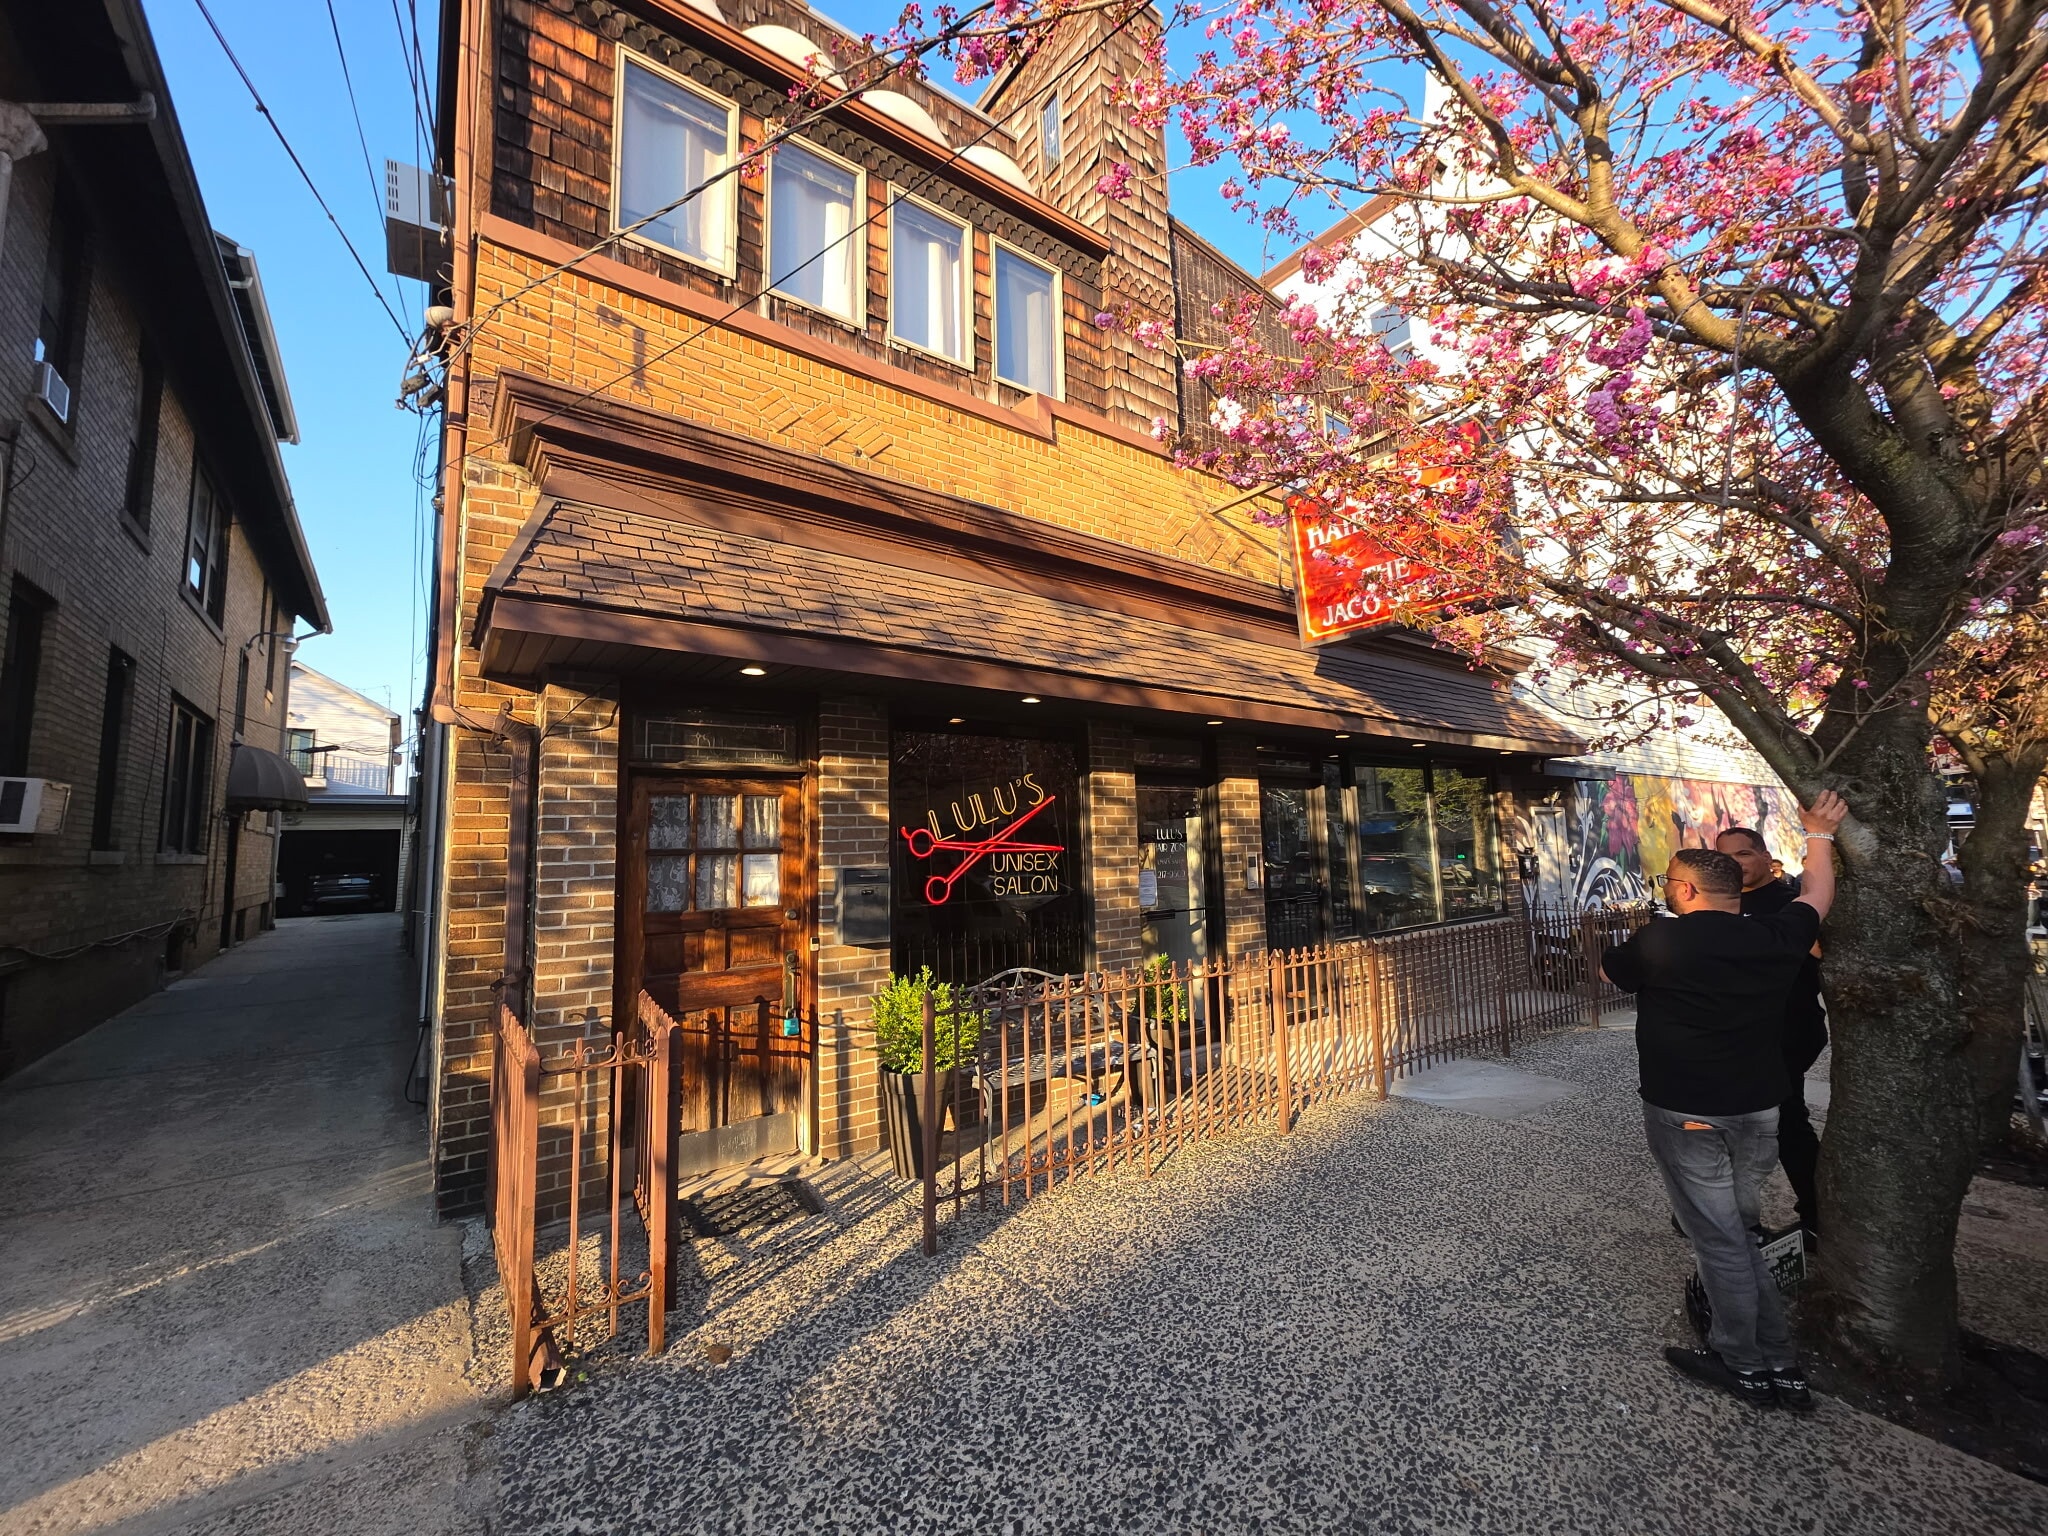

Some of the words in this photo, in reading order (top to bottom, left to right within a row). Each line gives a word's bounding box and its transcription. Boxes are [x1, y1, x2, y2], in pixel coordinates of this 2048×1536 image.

[1361, 556, 1411, 583] THE
[928, 772, 1044, 842] LULU'S
[1156, 828, 1183, 840] LULU'S
[993, 852, 1059, 873] UNISEX
[993, 875, 1058, 896] SALON
[1765, 1237, 1798, 1257] Please
[1783, 1259, 1798, 1271] UP
[1780, 1273, 1801, 1288] DOG
